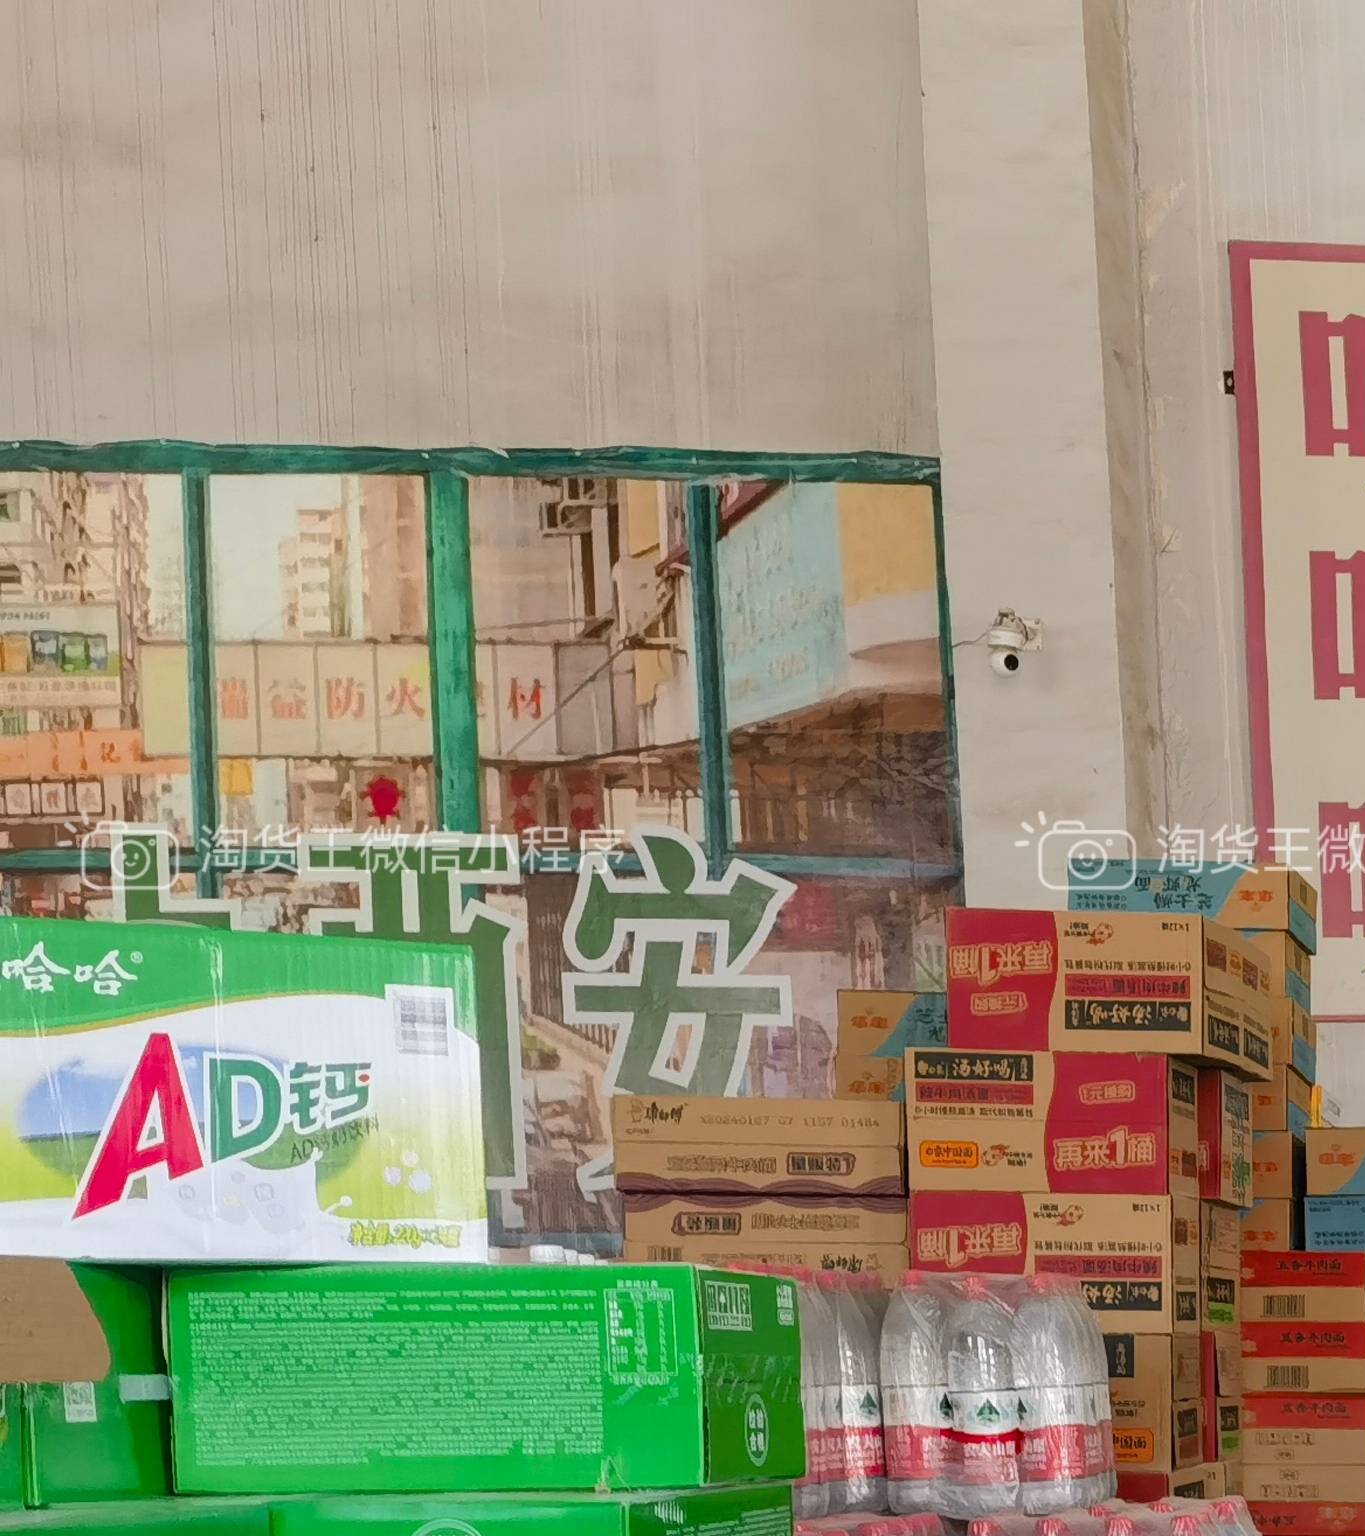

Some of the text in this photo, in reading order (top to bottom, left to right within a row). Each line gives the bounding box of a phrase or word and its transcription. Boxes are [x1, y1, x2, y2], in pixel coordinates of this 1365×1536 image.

[217, 676, 546, 722] 瑞益防火材
[949, 940, 1053, 986] 再来1桶
[73, 1030, 373, 1221] AD钙
[1053, 1125, 1156, 1170] 再来1桶
